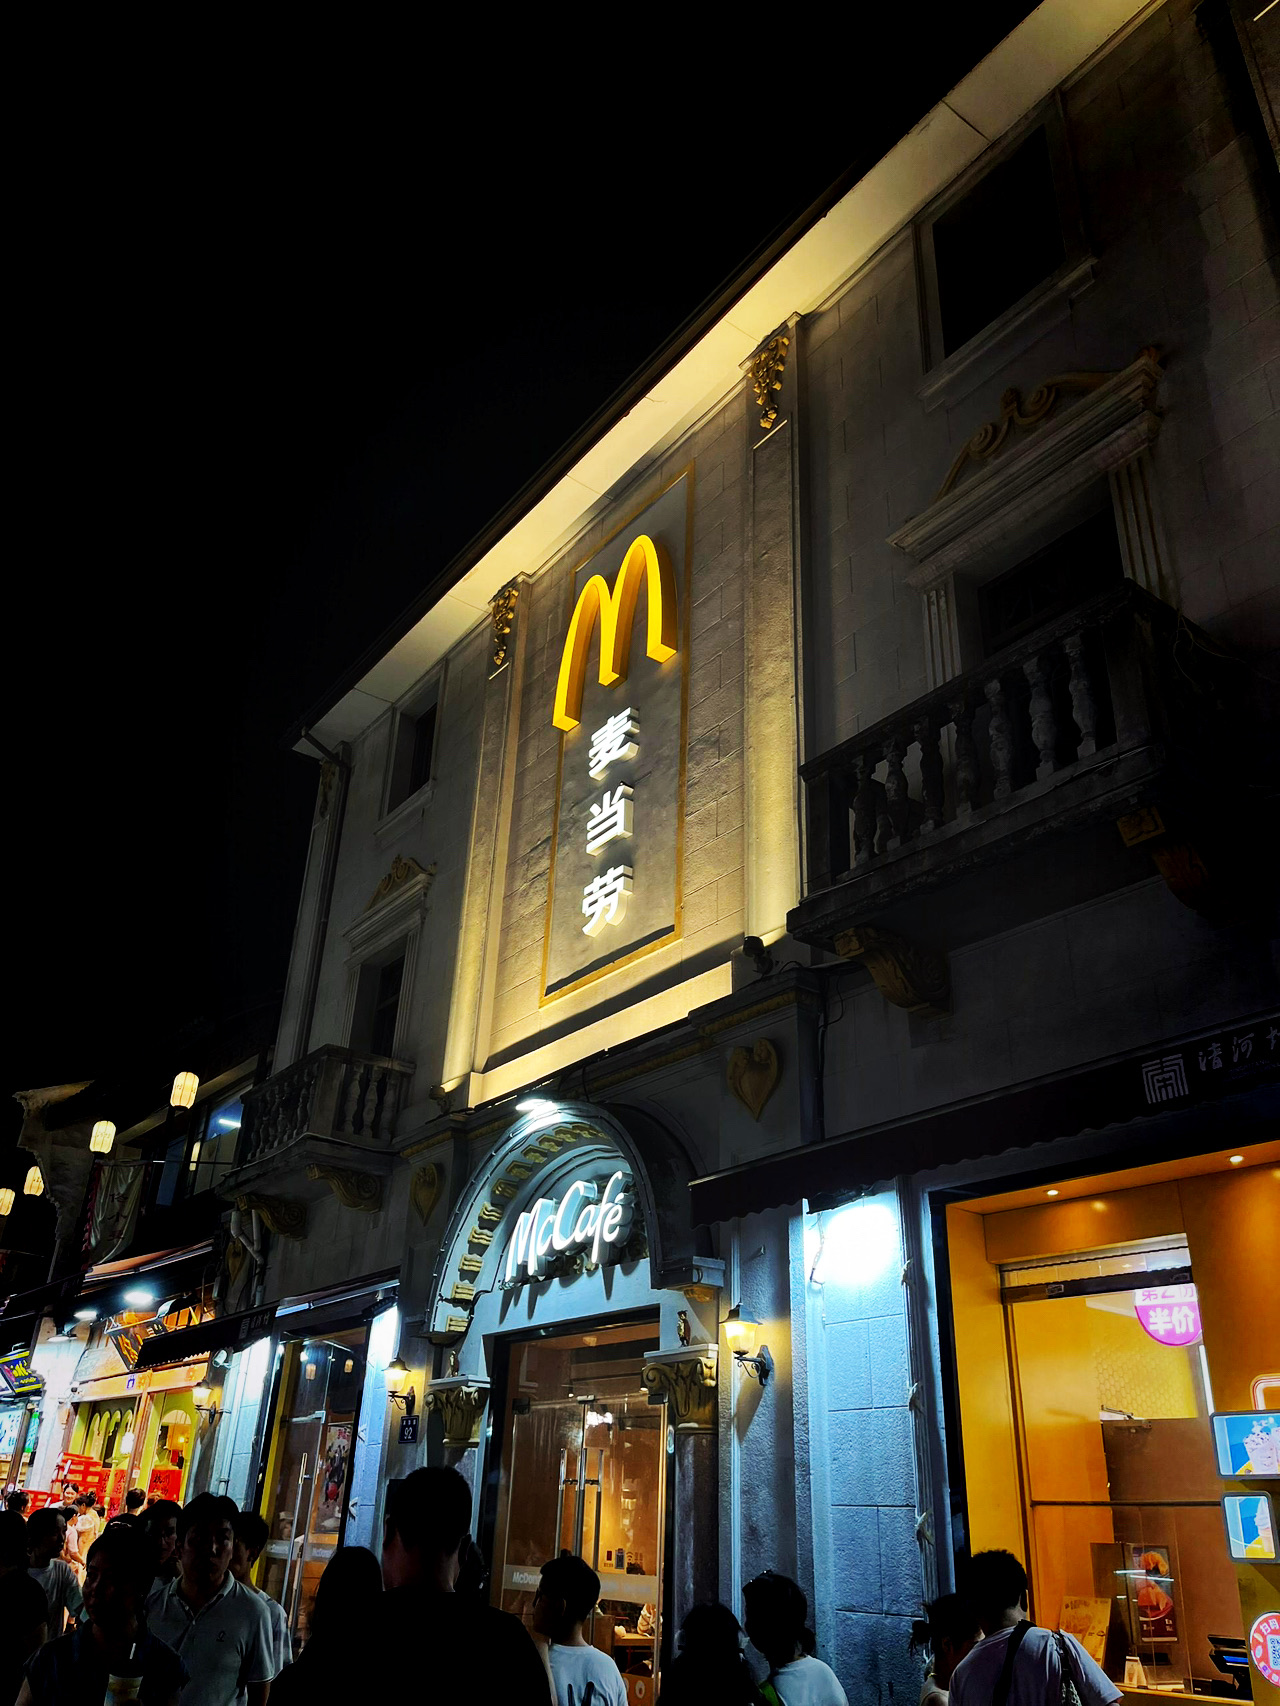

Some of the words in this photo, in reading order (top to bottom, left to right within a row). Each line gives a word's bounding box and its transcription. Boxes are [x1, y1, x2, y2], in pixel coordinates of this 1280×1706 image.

[582, 707, 638, 937] 麦当劳
[505, 1170, 626, 1282] McCafé
[1149, 1306, 1195, 1335] 半价
